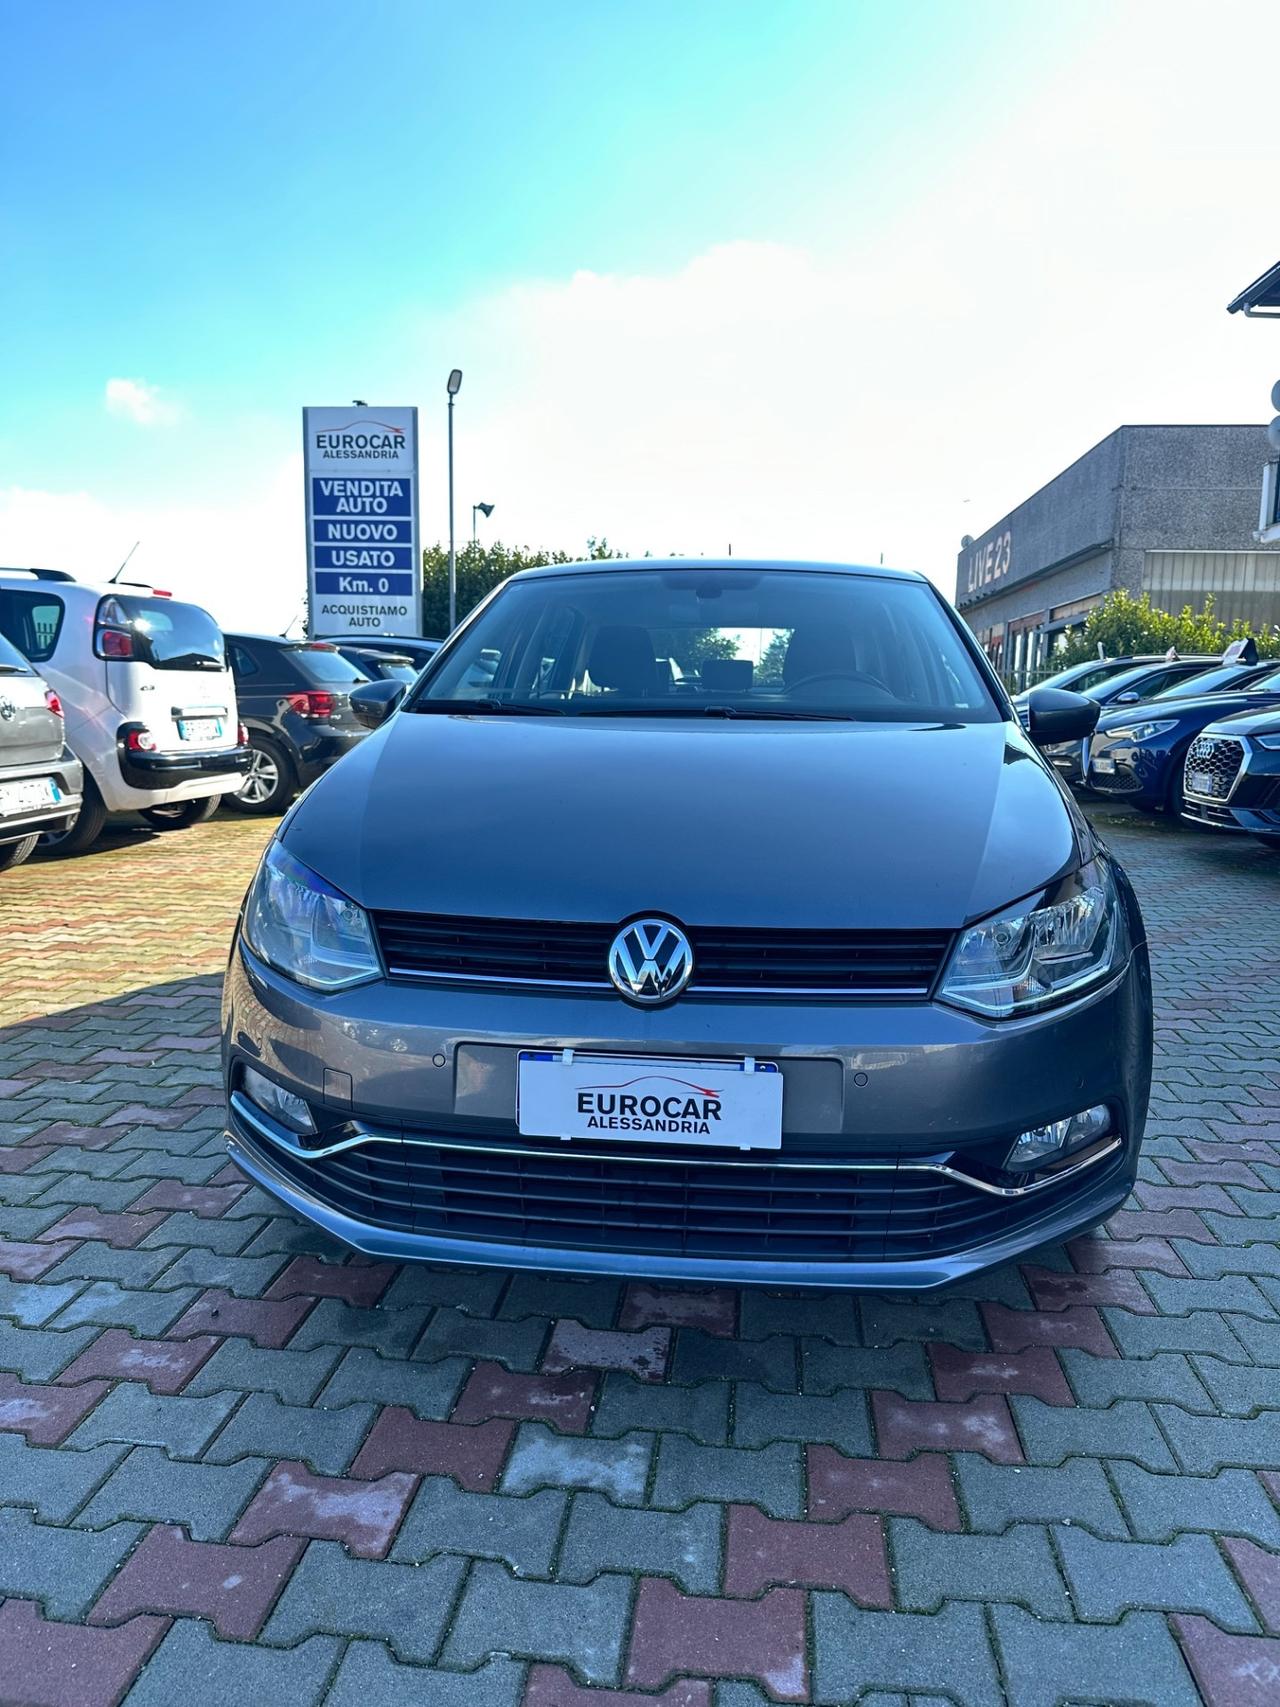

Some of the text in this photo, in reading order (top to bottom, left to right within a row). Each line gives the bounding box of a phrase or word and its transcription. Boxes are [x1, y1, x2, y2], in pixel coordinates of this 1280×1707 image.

[316, 434, 405, 450] EUROCAR
[322, 449, 399, 459] ALESSANDRIA
[320, 480, 403, 497] VENDITA
[336, 497, 388, 513] AUTO
[327, 524, 398, 541] NUOVO
[331, 550, 395, 567] USATO
[338, 577, 390, 593] Km. 0
[321, 604, 408, 616] ACQUISTIAMO
[348, 616, 381, 628] AUTO
[577, 1092, 722, 1121] EUROCAR
[587, 1115, 711, 1135] ALESSANDRIA
